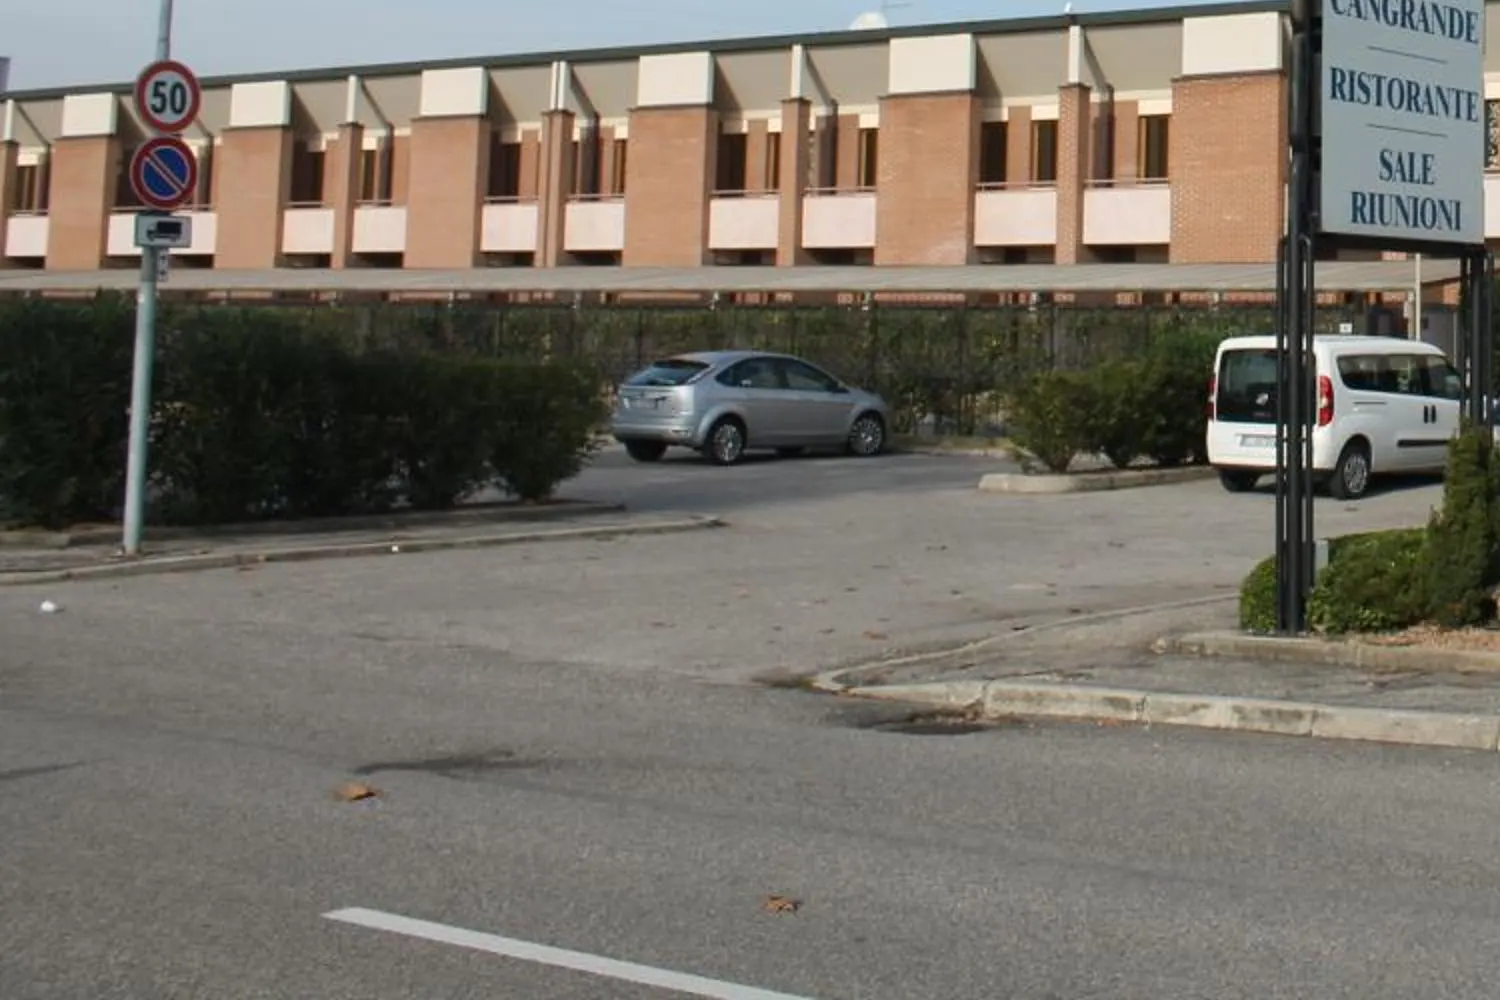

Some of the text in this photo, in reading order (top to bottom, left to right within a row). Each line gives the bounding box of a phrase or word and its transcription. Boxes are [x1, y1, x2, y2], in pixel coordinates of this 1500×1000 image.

[150, 81, 187, 115] 50
[1330, 67, 1479, 122] RISTORANTE
[1379, 149, 1435, 184] SALE
[1351, 191, 1461, 231] RIUNIONI
